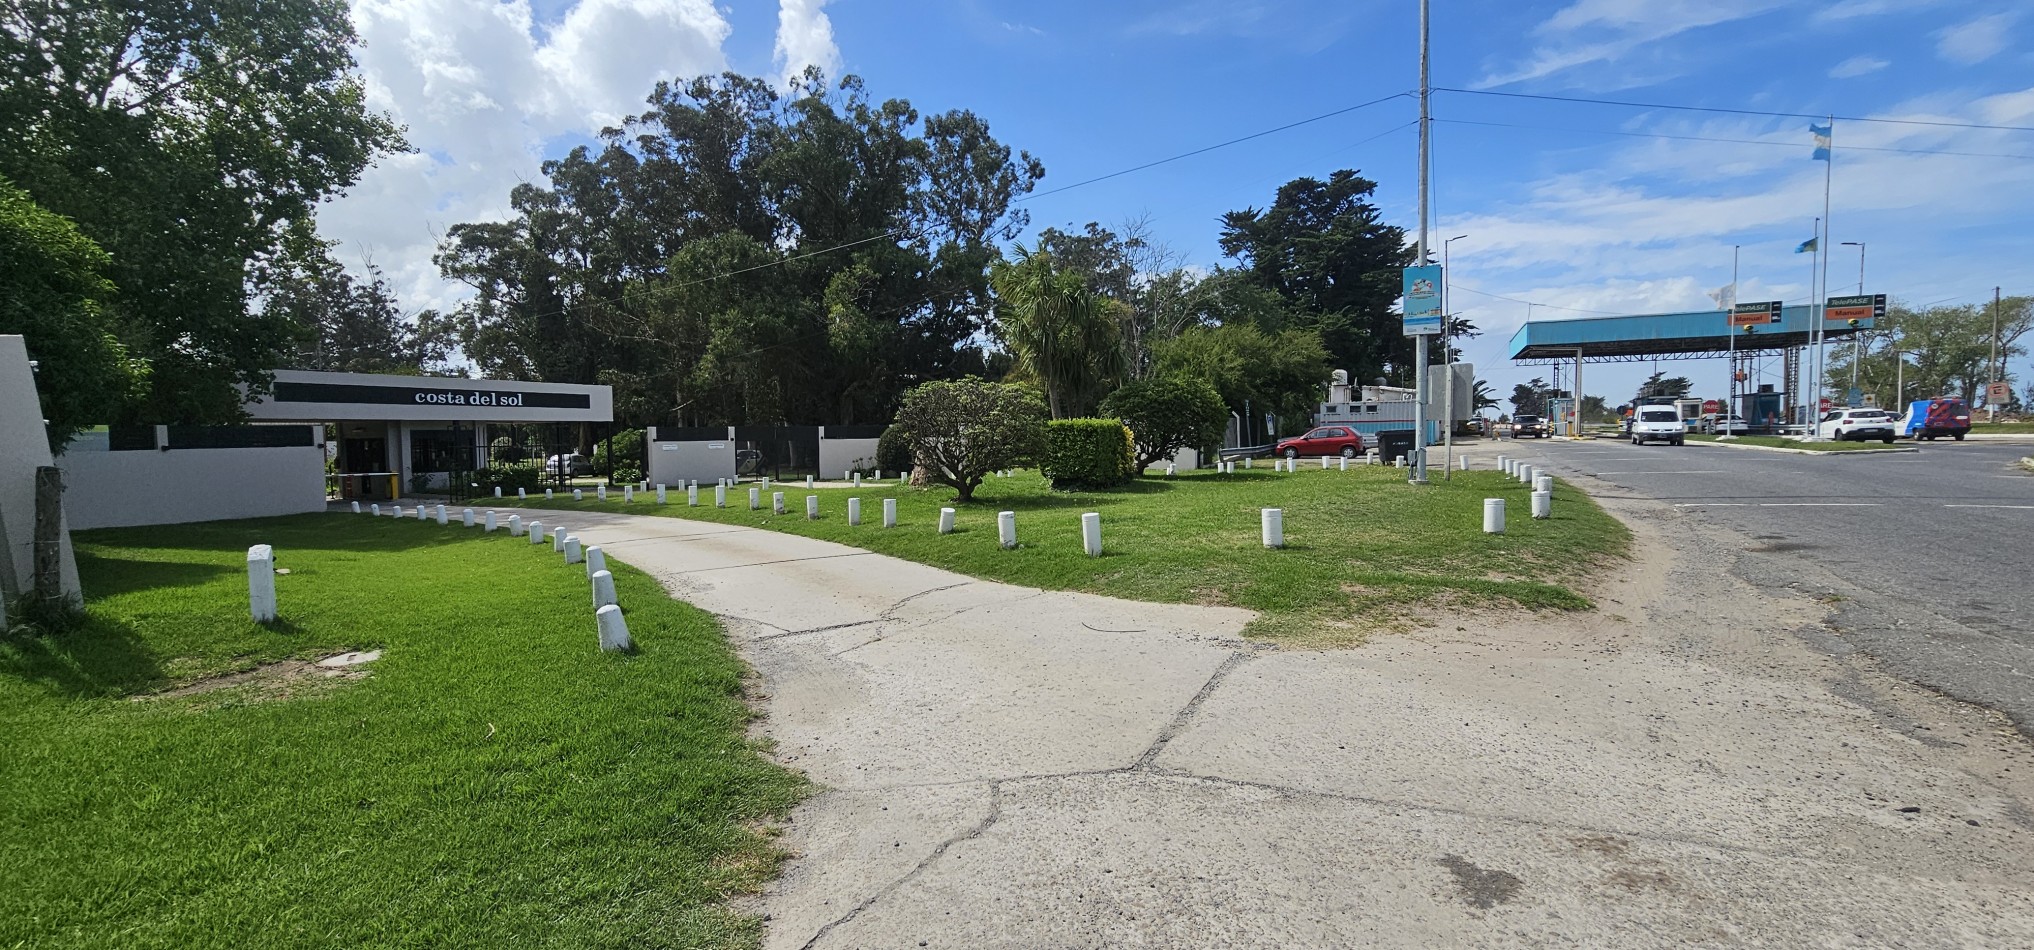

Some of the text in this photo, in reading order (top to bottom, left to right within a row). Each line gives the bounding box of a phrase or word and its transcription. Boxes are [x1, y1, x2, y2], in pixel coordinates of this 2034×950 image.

[1831, 297, 1869, 306] TelePASE
[1735, 304, 1767, 312] elePASE
[415, 391, 523, 406] costa del sol
